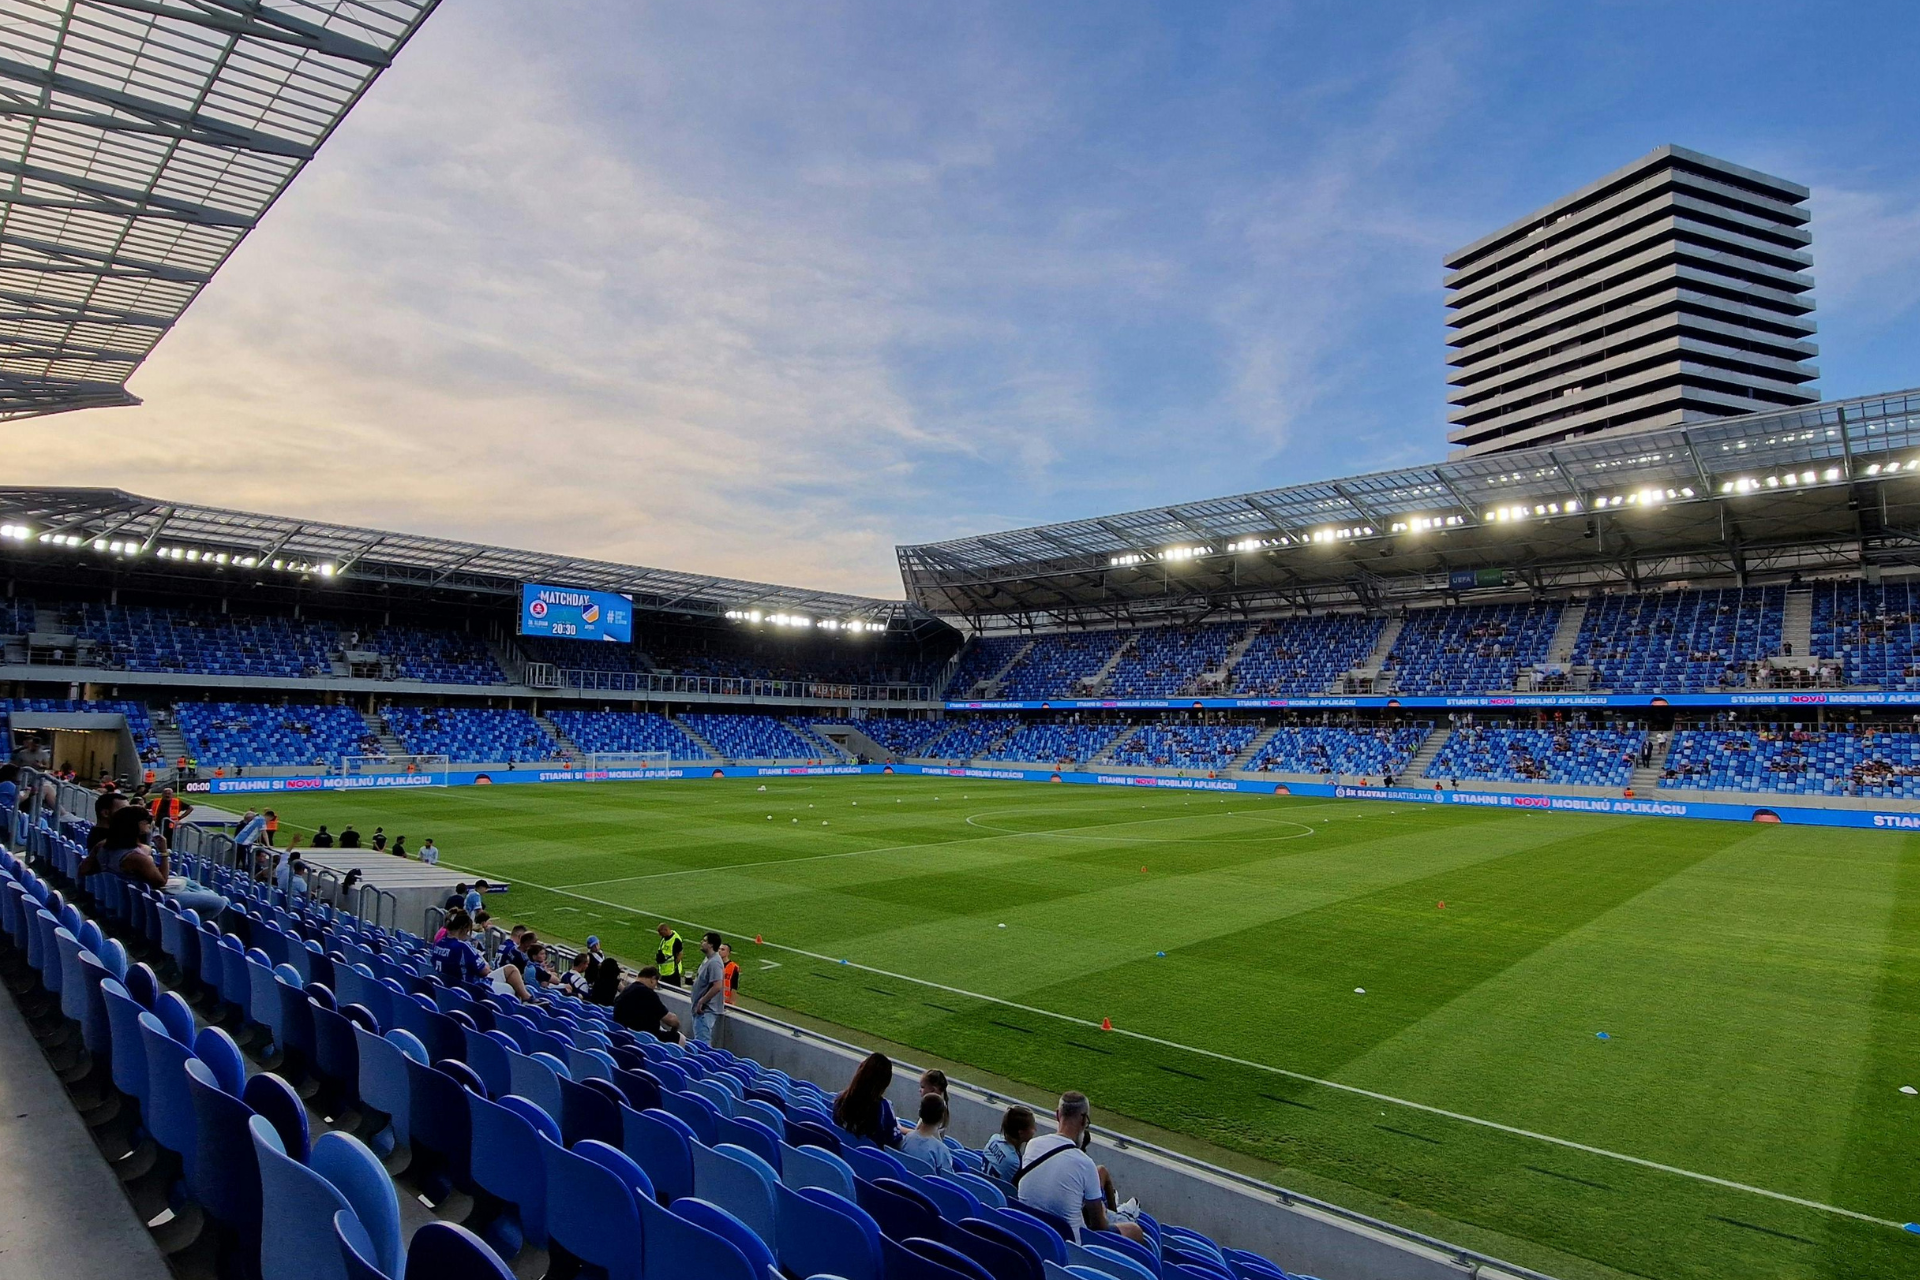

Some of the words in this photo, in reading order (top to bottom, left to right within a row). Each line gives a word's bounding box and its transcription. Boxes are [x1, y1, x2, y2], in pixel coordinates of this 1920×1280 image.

[1452, 576, 1472, 584] UEFA
[540, 590, 590, 606] MATCHDAY
[552, 623, 576, 635] 20:30
[1516, 696, 1556, 705] MOBILNÚ
[1558, 695, 1607, 704] APLIKÁCIU
[1731, 696, 1776, 704] STIAHNI
[1778, 696, 1789, 704] SI
[1791, 693, 1827, 704] NOVÚ
[1829, 693, 1885, 704] MOBILNÚ
[575, 770, 584, 779] SI
[609, 767, 643, 778] MOBILNÚ
[186, 782, 210, 792] 00:00
[219, 780, 270, 791] STIAHNI
[273, 780, 284, 790] SI
[286, 775, 321, 789] NOVÚ
[324, 774, 374, 788] MOBILNÚ
[376, 773, 432, 786] APLIKÁCIU
[1098, 776, 1126, 785] STIAHNI
[1127, 777, 1134, 786] SI
[1134, 776, 1157, 787] NOVÚ
[1158, 777, 1192, 789] MOBILNÚ
[1194, 779, 1237, 790] APLIKÁCIU
[1346, 788, 1356, 796] ŠK
[1357, 790, 1387, 798] SLOVAN
[1388, 791, 1433, 801] BRATISLAVA
[1452, 793, 1498, 805] STIAHNI
[1500, 795, 1512, 805] SI
[1514, 795, 1550, 808] NOVÚ
[1552, 798, 1611, 811] MOBILNÚ
[1613, 801, 1687, 815] APLIKÁCIU
